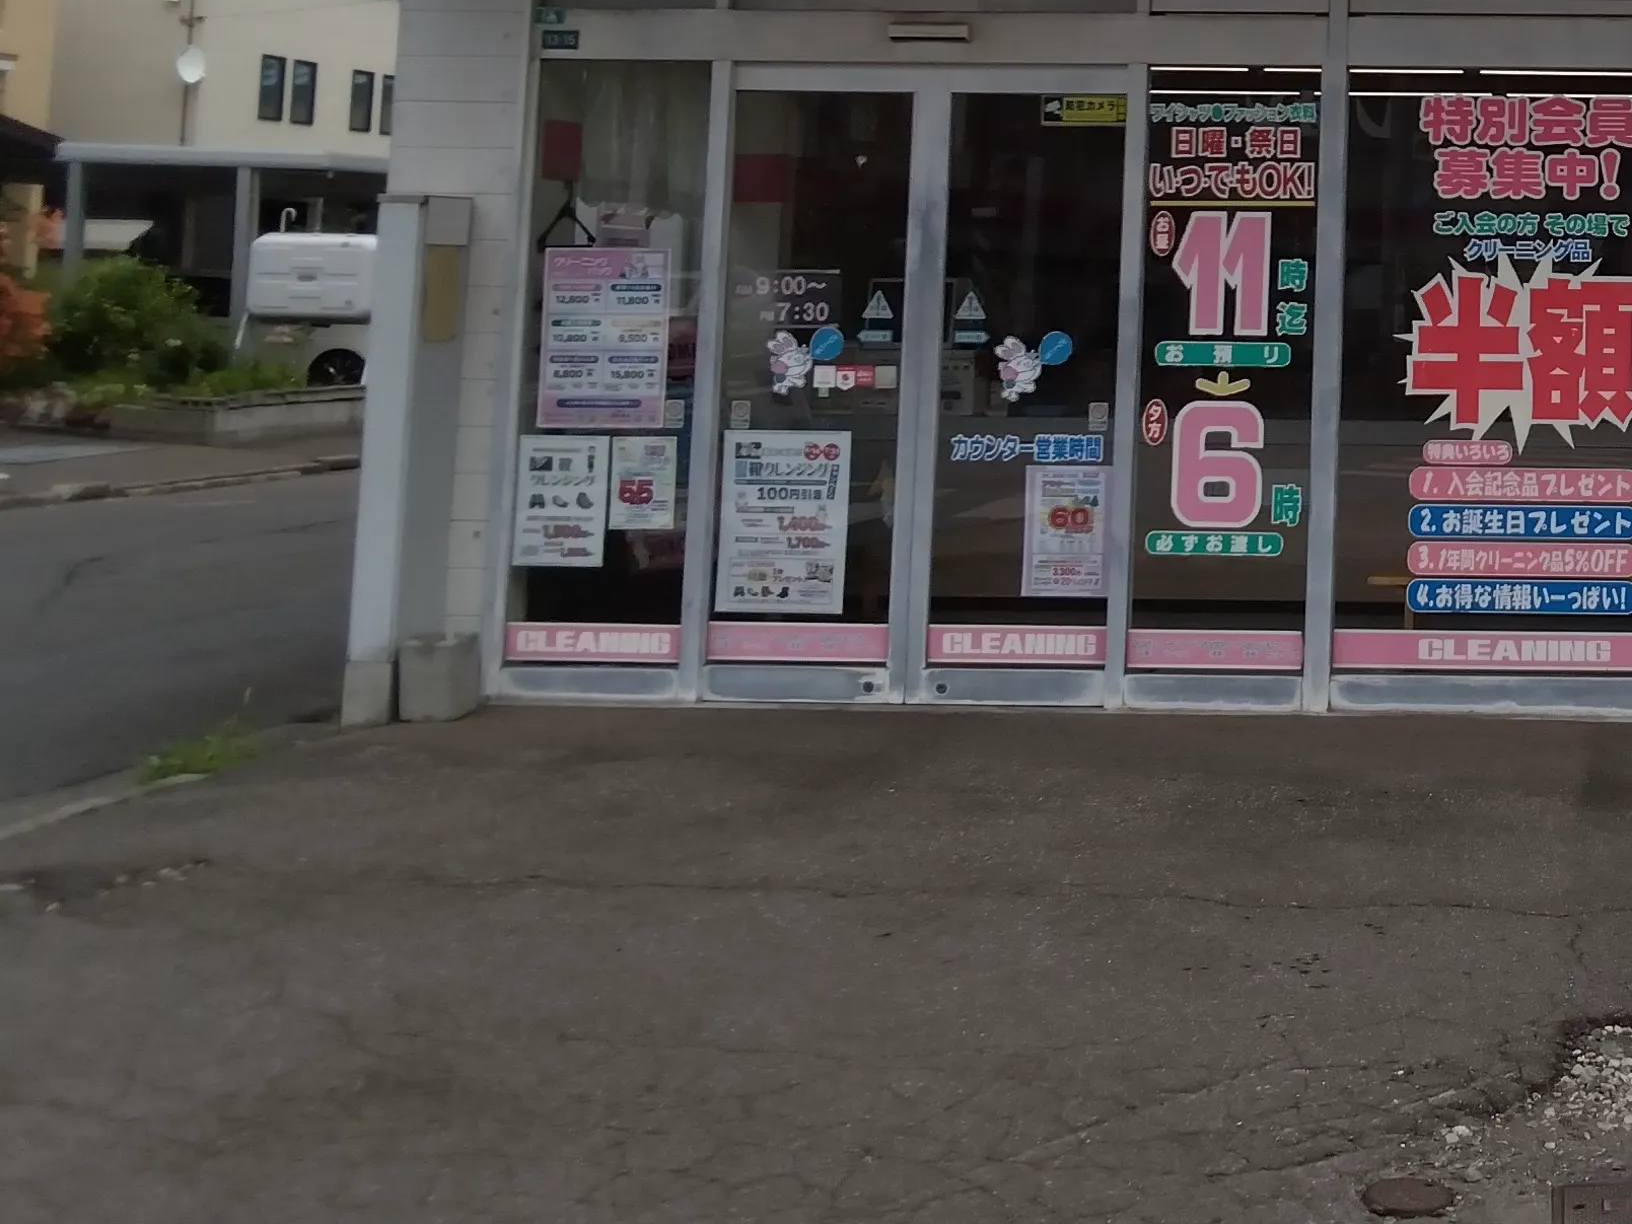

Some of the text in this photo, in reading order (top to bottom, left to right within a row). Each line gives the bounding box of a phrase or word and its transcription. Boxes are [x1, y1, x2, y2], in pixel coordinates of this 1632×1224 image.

[1171, 126, 1301, 158] 日曜・祭日
[1433, 148, 1621, 201] 募集中!
[1433, 211, 1631, 236] ご入会の方 その場で
[1465, 239, 1592, 262] クリーニング品
[1172, 211, 1272, 336] 11
[776, 302, 830, 322] 7:30
[950, 435, 1104, 462] カウンター営業時間
[1171, 400, 1265, 528] 6
[1271, 484, 1301, 527] 時
[516, 630, 671, 654] CLEANING
[941, 632, 1097, 656] CLEANING
[1417, 638, 1611, 662] CLEANING
